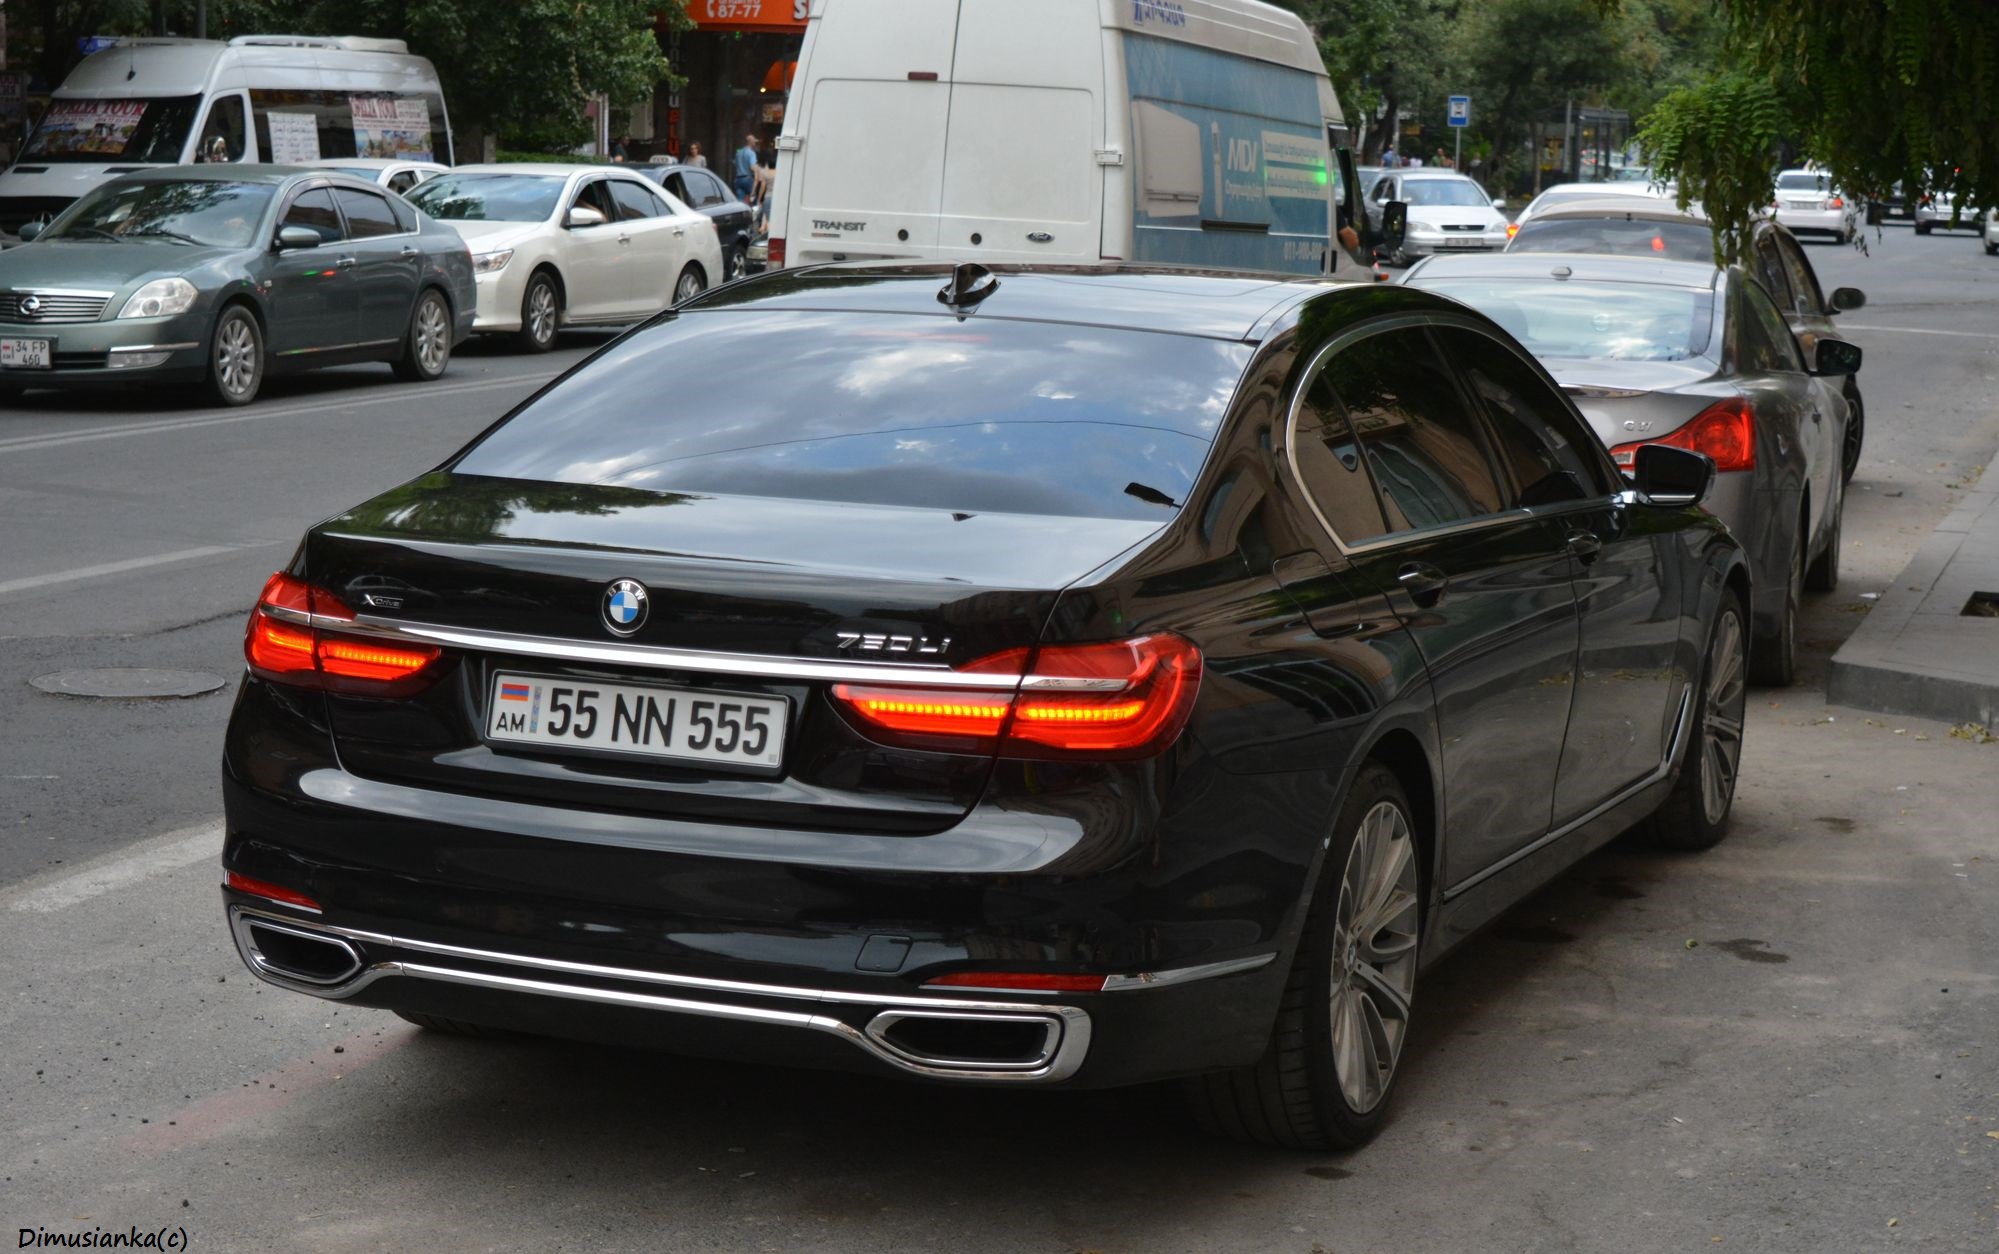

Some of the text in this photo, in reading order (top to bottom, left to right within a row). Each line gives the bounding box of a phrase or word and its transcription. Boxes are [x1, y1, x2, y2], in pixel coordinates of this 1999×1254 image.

[718, 5, 761, 18] 87-77
[103, 100, 148, 116] TOUR
[1227, 138, 1258, 173] MDV
[812, 219, 867, 231] TRANSIT
[15, 341, 46, 352] 34 FP
[608, 582, 646, 600] BMW
[496, 711, 526, 733] AM
[547, 687, 770, 756] 55 NN 555
